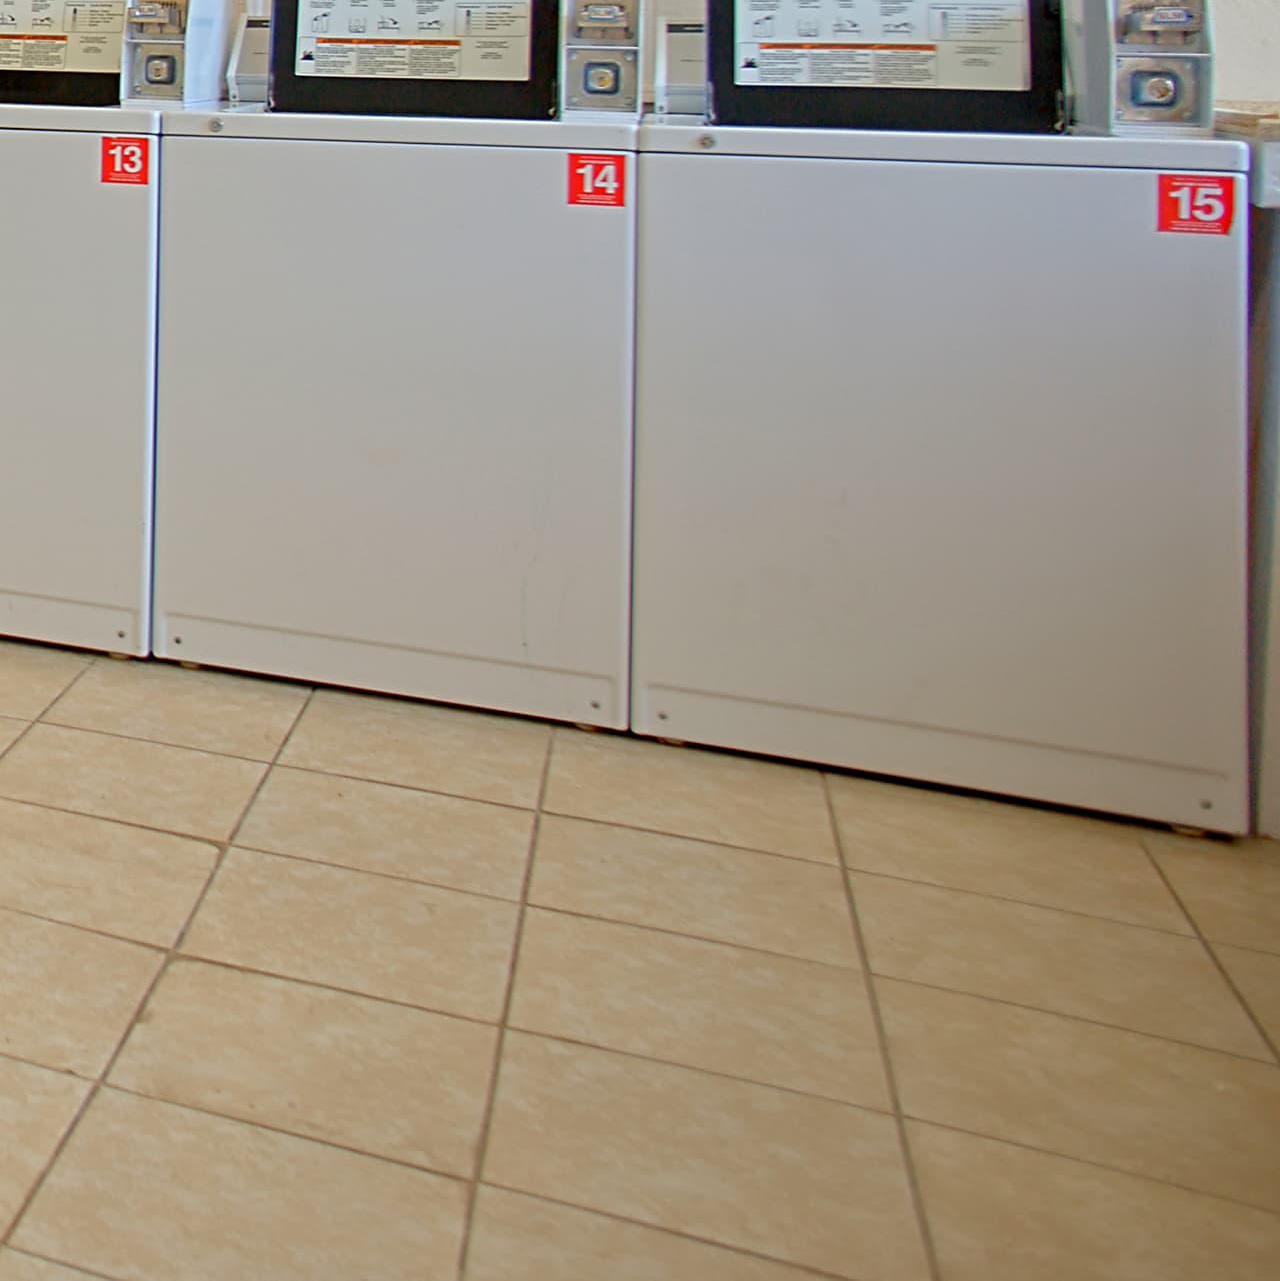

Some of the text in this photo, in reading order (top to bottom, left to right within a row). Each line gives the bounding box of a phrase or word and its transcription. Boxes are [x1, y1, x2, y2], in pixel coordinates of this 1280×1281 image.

[108, 145, 143, 173] 13
[576, 164, 619, 194] 14
[1168, 186, 1225, 221] 15
